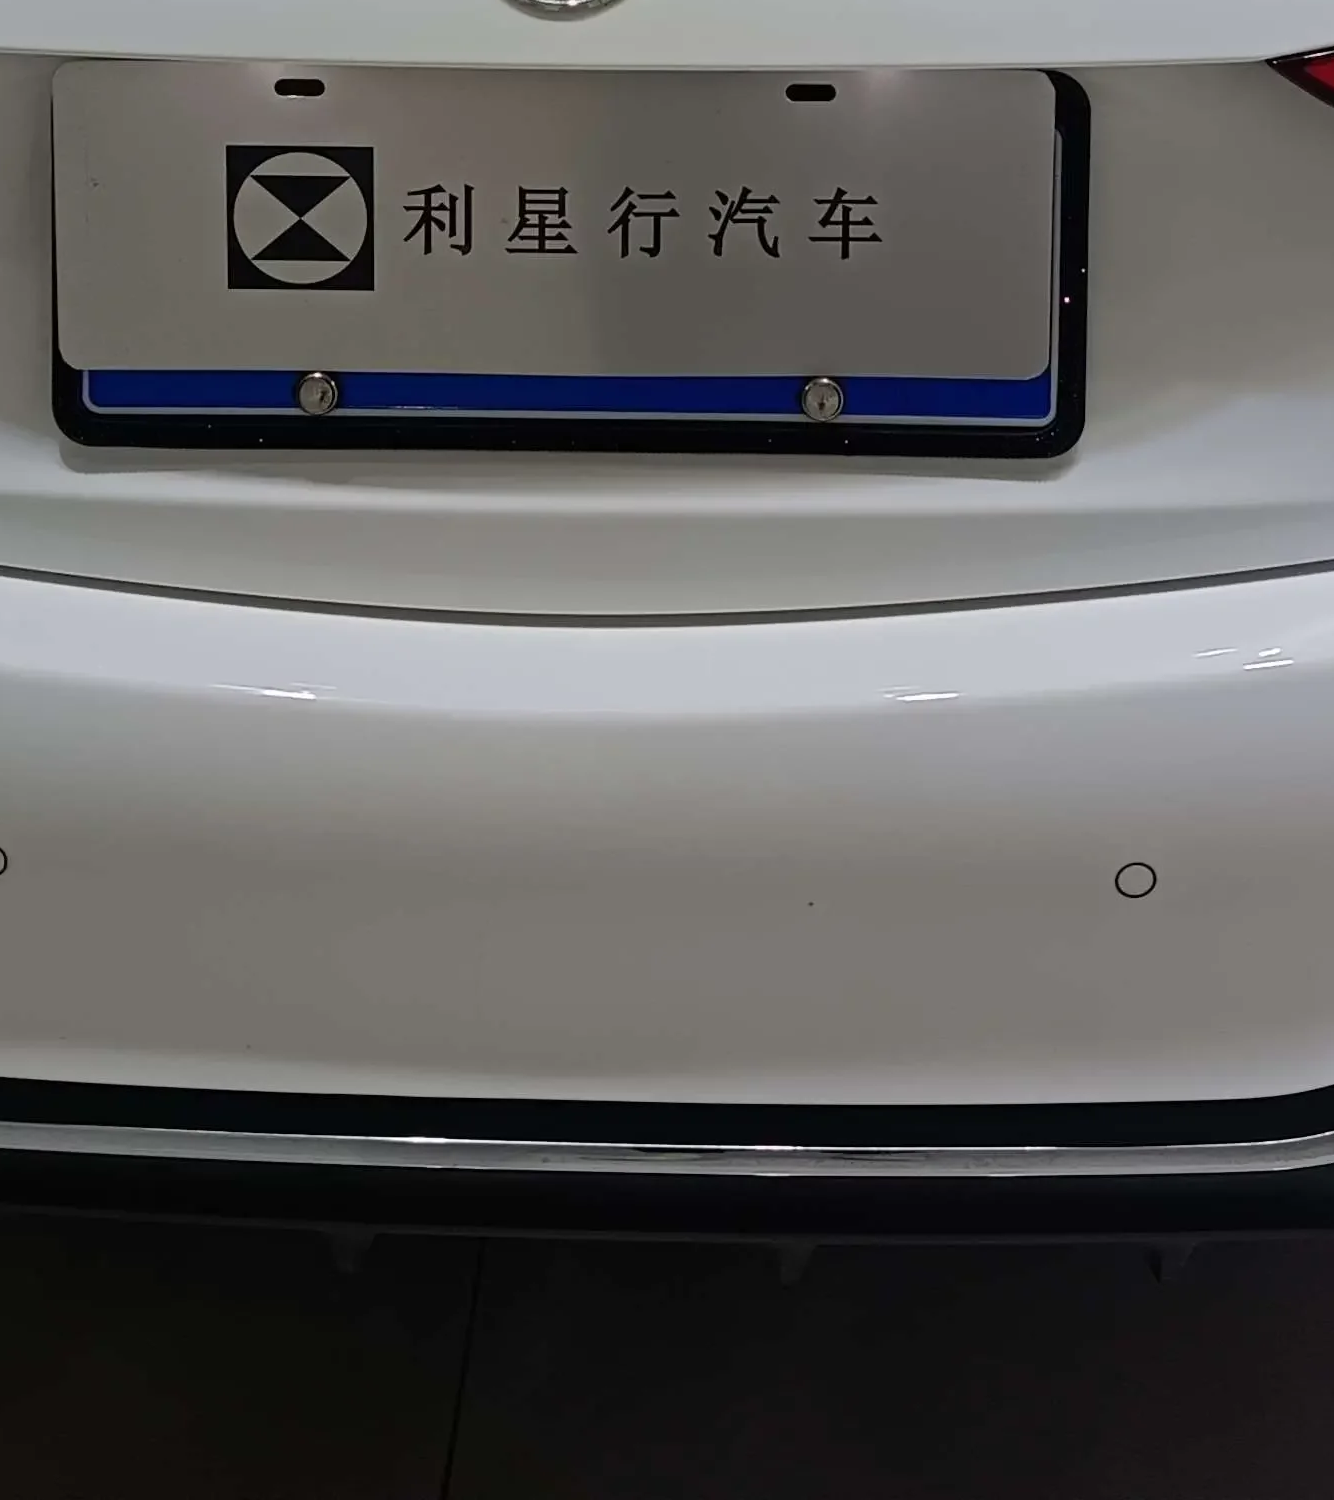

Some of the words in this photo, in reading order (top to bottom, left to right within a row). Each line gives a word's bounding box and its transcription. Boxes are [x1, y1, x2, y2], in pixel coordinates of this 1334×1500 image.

[402, 183, 883, 260] 利星行汽车
